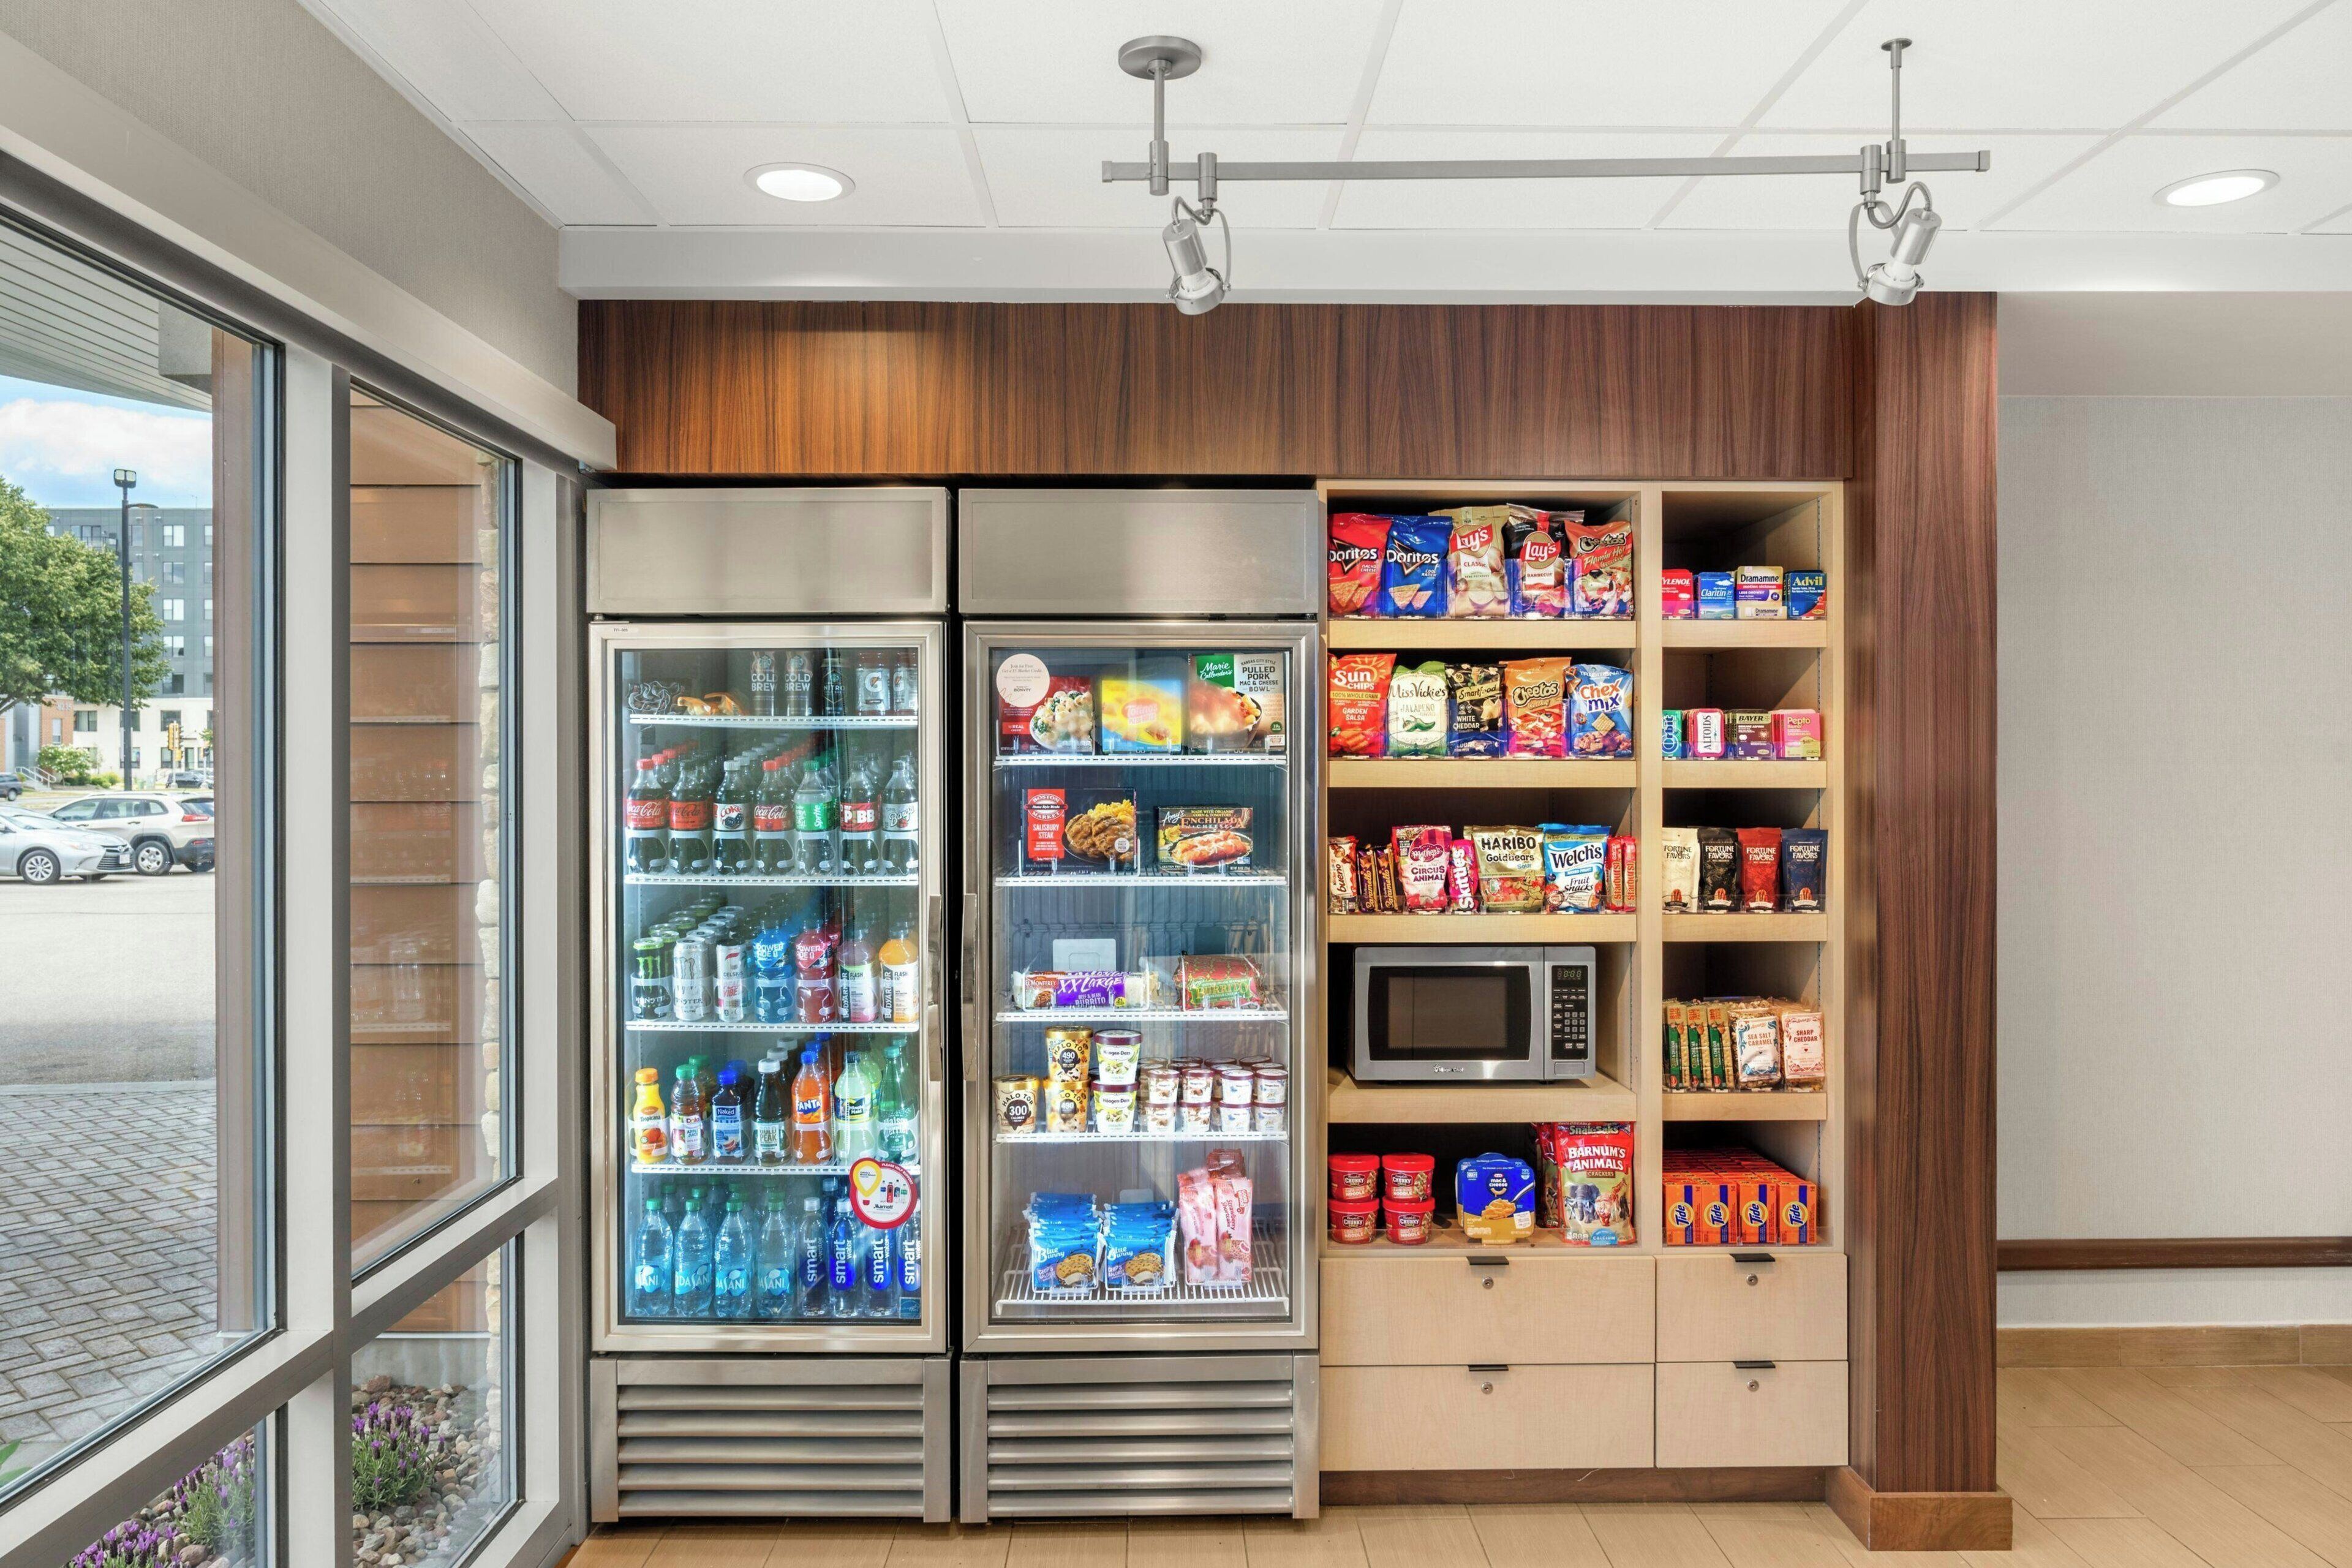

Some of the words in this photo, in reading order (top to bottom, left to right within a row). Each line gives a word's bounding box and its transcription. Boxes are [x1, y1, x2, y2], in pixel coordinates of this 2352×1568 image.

[1457, 528, 1489, 551] Lay's
[1580, 533, 1626, 552] Cheetos
[1329, 549, 1378, 562] Doritos
[1387, 549, 1439, 564] Doritos
[1525, 541, 1556, 562] Lay's
[1793, 576, 1823, 586] Advil
[1200, 662, 1230, 673] Marie
[865, 672, 883, 692] G
[1334, 669, 1371, 687] Sun
[752, 682, 777, 692] BREW
[785, 682, 810, 692] BREW
[1388, 685, 1412, 699] Miss
[1411, 680, 1446, 699] Vickie's
[1458, 686, 1496, 699] Smartfood
[1513, 682, 1558, 705] Cheetos
[1580, 680, 1621, 699] Chex
[1588, 694, 1620, 710] mix
[1703, 715, 1712, 750] ALTOIDS
[754, 805, 788, 819] Coca-Cola
[889, 806, 915, 827] Barq's
[1162, 809, 1186, 827] Amy's
[1180, 816, 1246, 829] ENCHILADA
[1480, 837, 1536, 851] HARIBO
[1412, 850, 1441, 859] Mother's
[1551, 845, 1602, 869] Welch's
[1336, 864, 1347, 892] bueno
[1570, 876, 1589, 886] Fruit
[1563, 883, 1594, 892] Snacks
[723, 988, 737, 997] VIBE
[1075, 997, 1106, 1006] BURRITO
[1054, 1042, 1071, 1055] HALO
[1074, 1043, 1085, 1055] TOP
[797, 1099, 821, 1110] FANTA
[1003, 1093, 1020, 1106] HALO
[1023, 1093, 1033, 1105] TOP
[1074, 1093, 1083, 1104] TOP
[1009, 1106, 1027, 1116] 300
[1569, 1125, 1619, 1135] Snak-Saks
[1568, 1147, 1626, 1159] BARNUM'S
[1572, 1158, 1624, 1171] ANIMALS
[1675, 1204, 1689, 1225] Tide
[1710, 1204, 1725, 1225] Tide
[1749, 1203, 1763, 1225] Tide
[1789, 1204, 1803, 1225] Tide
[804, 1238, 817, 1282] smart
[834, 1239, 846, 1284] smart
[872, 1238, 884, 1283] smart
[903, 1240, 915, 1284] smart
